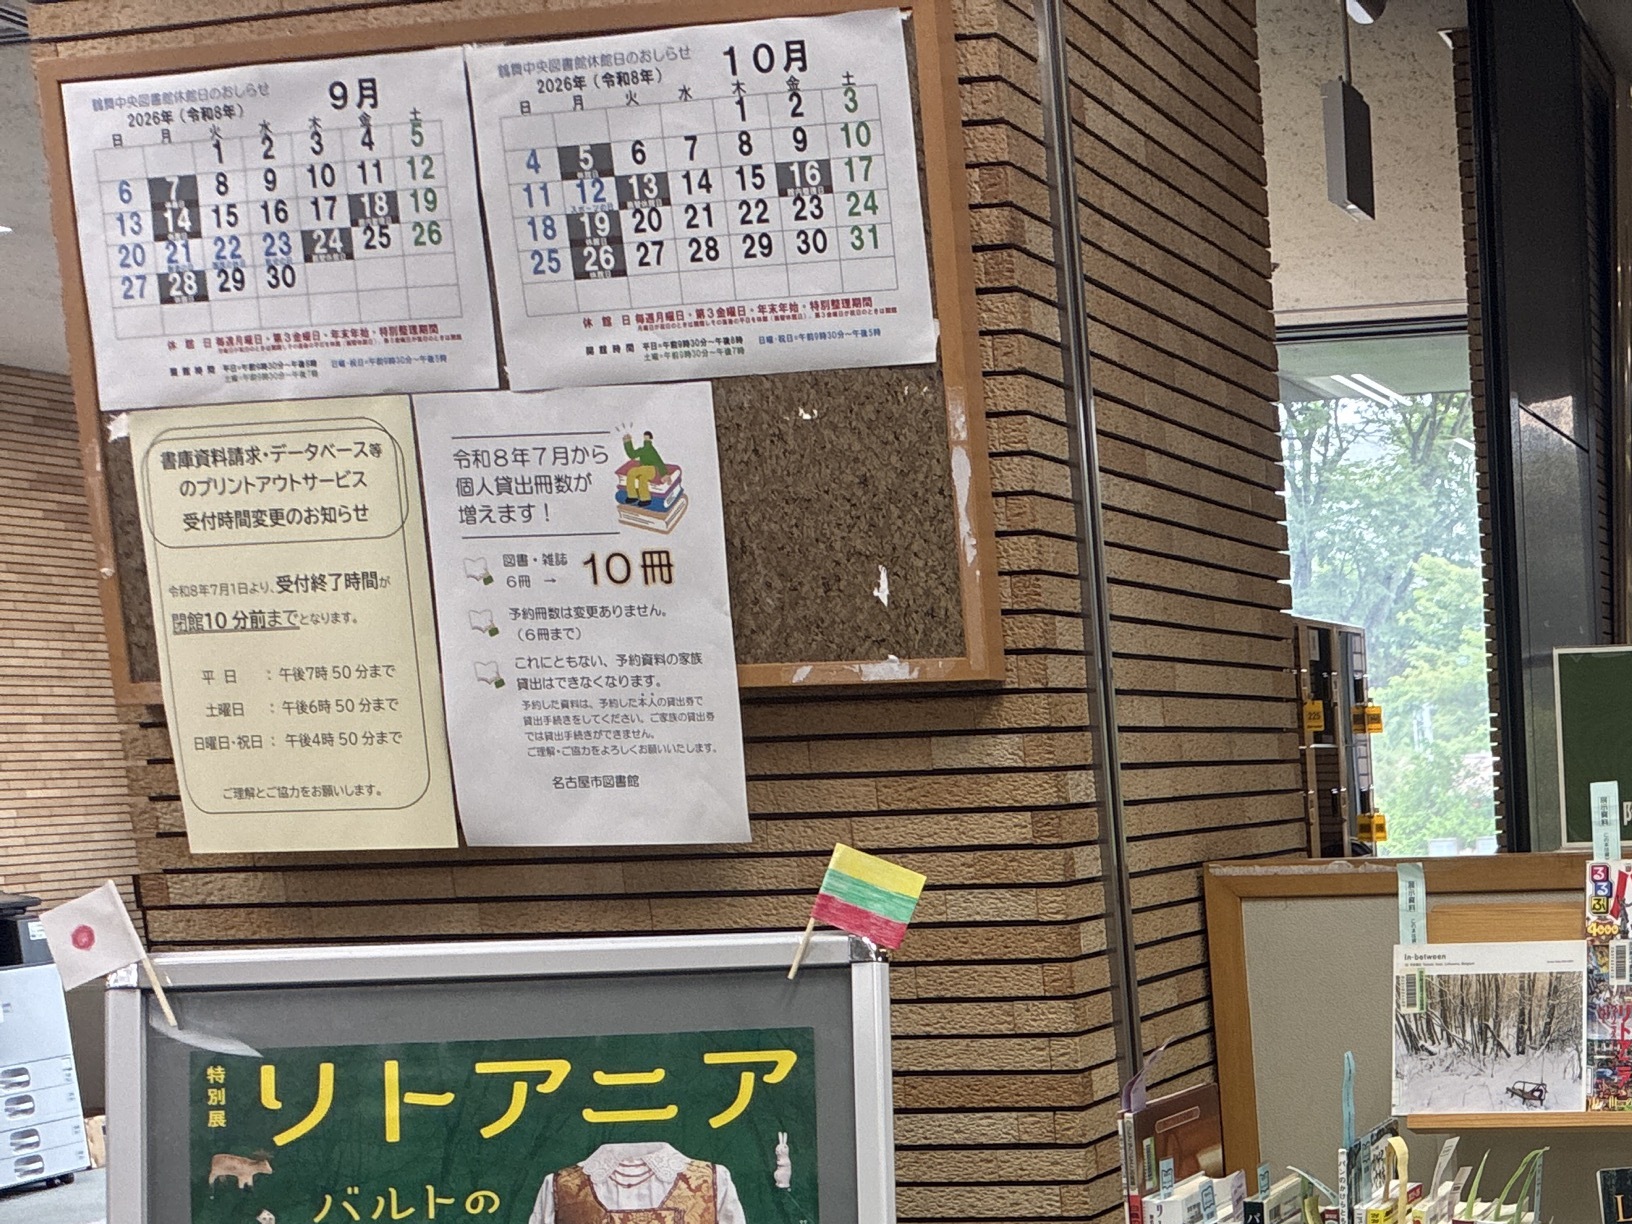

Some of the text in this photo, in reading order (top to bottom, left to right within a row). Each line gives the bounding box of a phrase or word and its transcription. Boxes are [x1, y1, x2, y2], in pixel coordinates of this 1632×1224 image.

[724, 40, 808, 76] 10月
[329, 77, 379, 110] 9月
[212, 123, 424, 163] 1 2 3 4 5
[525, 122, 871, 174] 4 5 6 7 8 9 10
[452, 445, 609, 470] 令和8年7月から
[456, 473, 593, 498] 個人貸出冊数が
[182, 505, 369, 532] 受付時間変更のお知らせ
[509, 605, 668, 622] 予約冊数は変更ありません。
[515, 652, 703, 669] これにともない、予約資料の家族
[516, 674, 662, 691] 貸出はできなくなります。
[205, 702, 245, 718] 土曜日
[223, 782, 383, 800] ご理解とご協力をお願いします。
[551, 774, 640, 789] 名古屋市図書館
[206, 1065, 227, 1129] 特別展
[260, 1049, 799, 1146] リトアニア
[313, 1184, 500, 1223] バルトの
